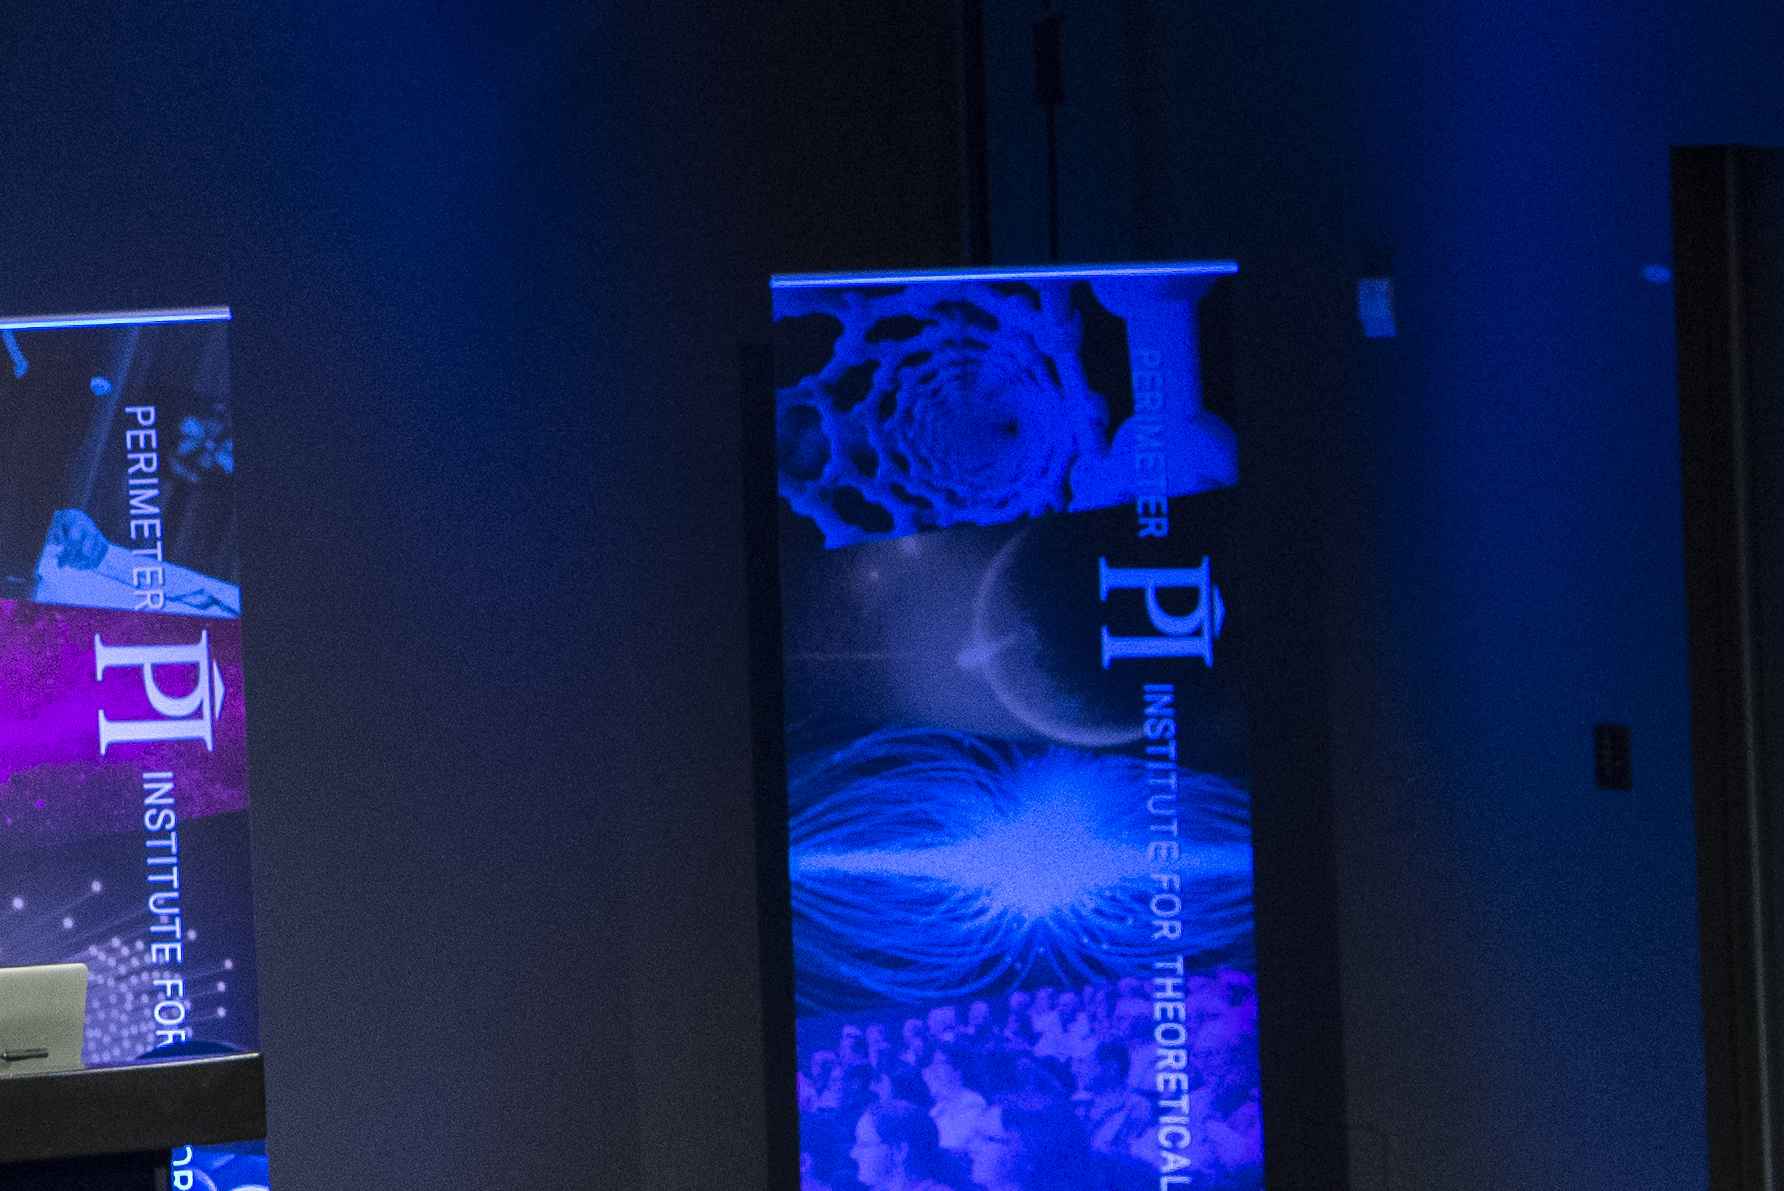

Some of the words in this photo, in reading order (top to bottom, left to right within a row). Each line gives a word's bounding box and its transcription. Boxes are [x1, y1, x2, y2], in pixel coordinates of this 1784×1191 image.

[125, 406, 165, 611] PERIMETER
[1133, 349, 1169, 538] PERIMETER
[1099, 555, 1226, 670] PI
[95, 629, 226, 755] PI
[1143, 683, 1179, 861] INSTITUTE
[143, 772, 183, 964] INSTITUTE
[1150, 873, 1182, 940] FOR
[152, 978, 185, 1049] FOR
